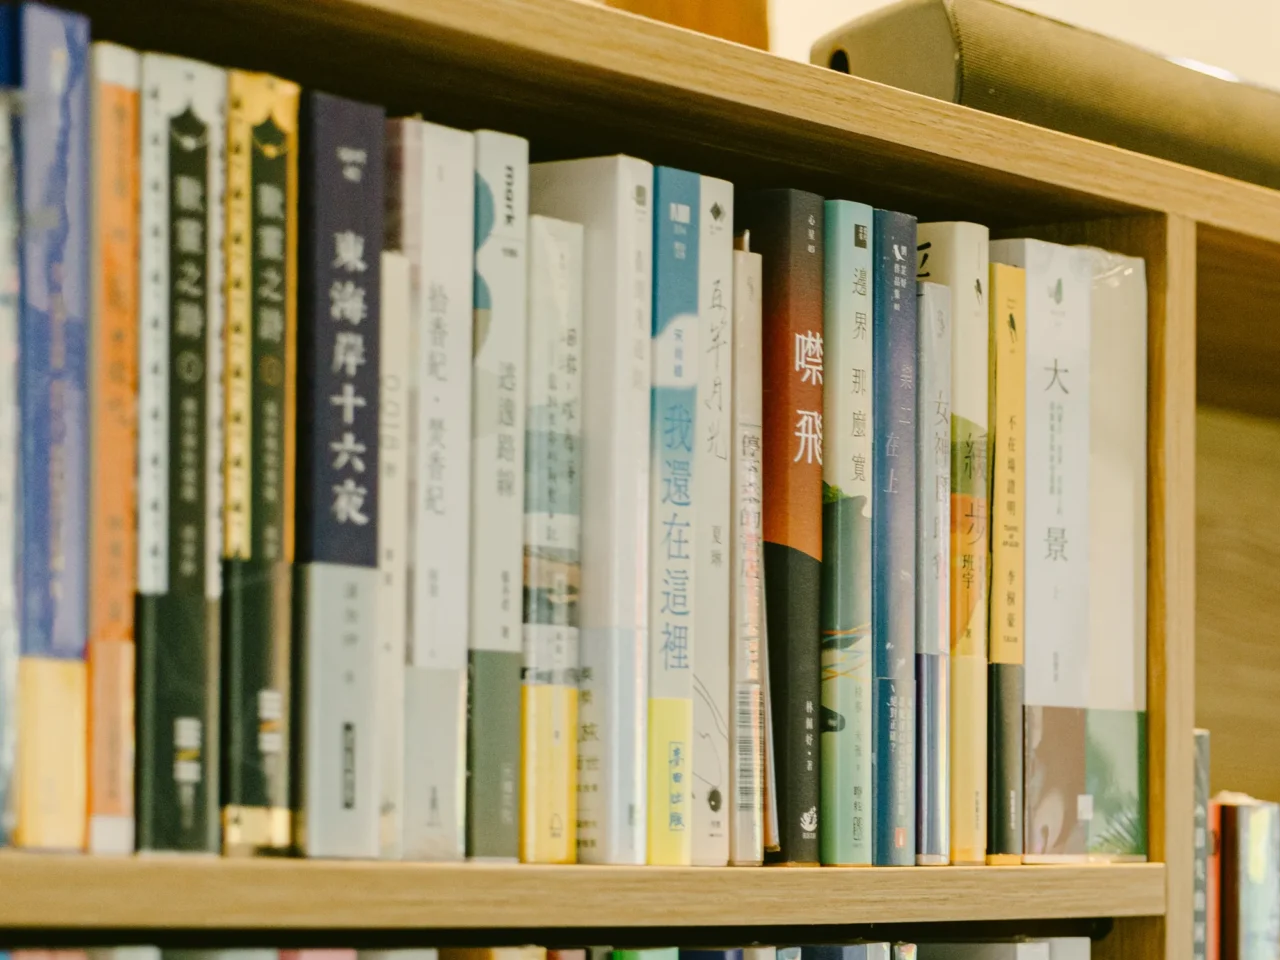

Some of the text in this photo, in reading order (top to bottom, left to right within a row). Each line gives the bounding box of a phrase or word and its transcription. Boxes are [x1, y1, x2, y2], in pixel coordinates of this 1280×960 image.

[504, 165, 515, 227] mark
[329, 230, 370, 526] 東海岸十六夜
[793, 330, 823, 466] 噤飛
[659, 403, 694, 671] 我還在這裡
